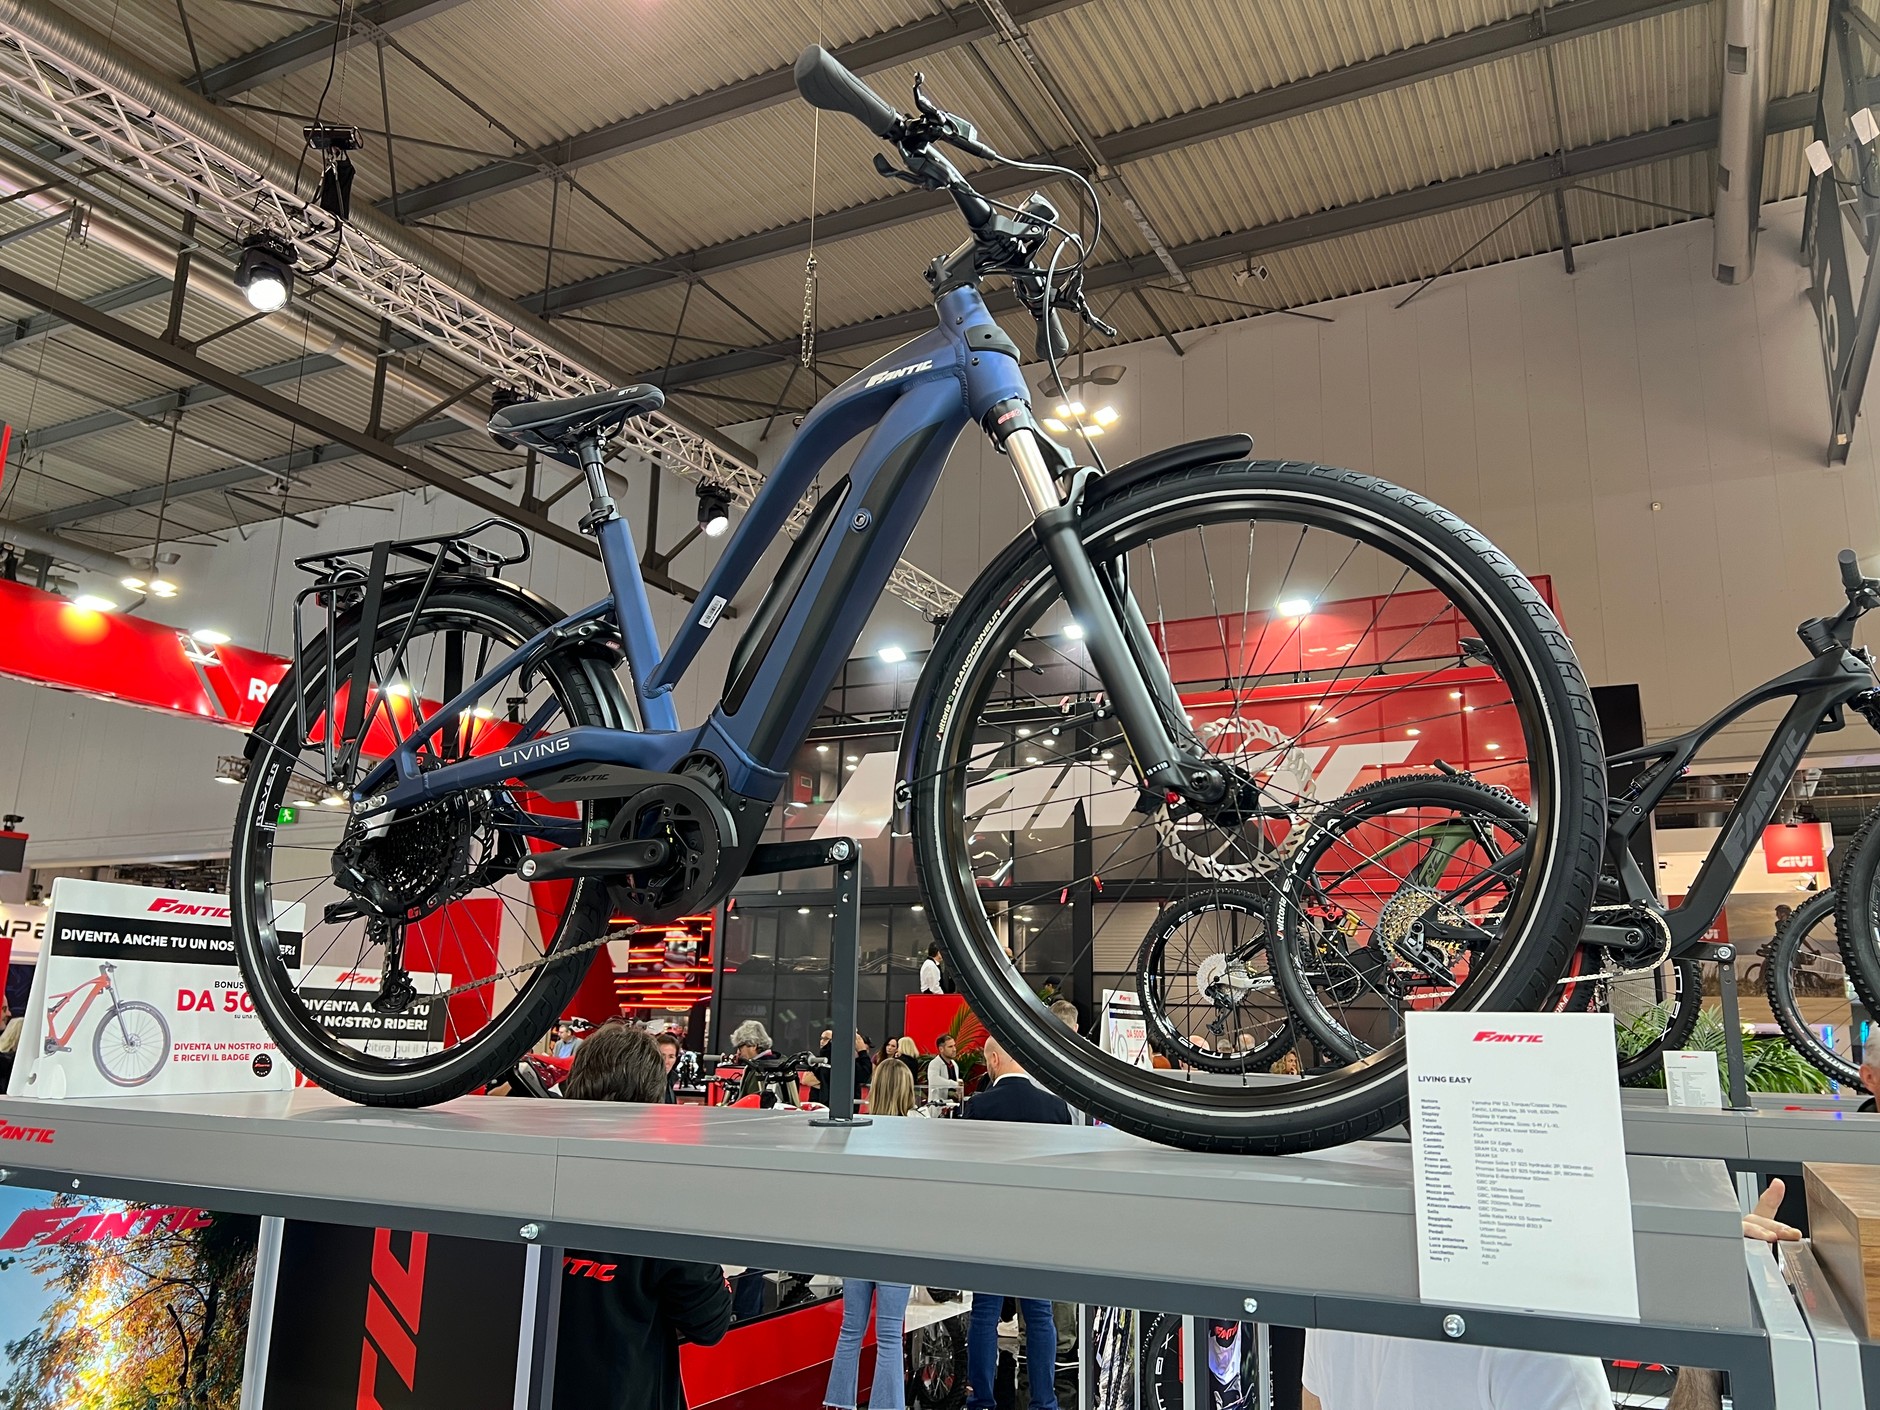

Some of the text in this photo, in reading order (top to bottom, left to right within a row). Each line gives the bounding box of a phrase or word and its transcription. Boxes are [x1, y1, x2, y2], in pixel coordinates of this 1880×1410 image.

[865, 360, 932, 388] FANTIC
[499, 737, 570, 767] LIVING
[557, 774, 609, 784] FANTIC
[256, 763, 278, 826] ROVER
[1721, 728, 1807, 872] FANTIC
[1776, 856, 1814, 868] GIVI
[147, 898, 232, 918] FANTIC
[1277, 897, 1286, 931] vittoria
[61, 929, 119, 944] DIVENTA
[123, 933, 168, 947] ANCHE
[171, 936, 187, 948] TU
[190, 938, 207, 950] UN
[210, 940, 235, 952] NOS
[214, 981, 244, 989] BONUS
[177, 989, 215, 1012] DA
[301, 999, 360, 1013] DIVENTA
[413, 1005, 430, 1015] TU
[324, 1016, 381, 1028] NOSTRO
[384, 1019, 427, 1030] RIDER!
[1472, 1031, 1544, 1043] FANTIC
[1418, 1076, 1472, 1084] LIVING EASY
[0, 1205, 214, 1250] FANTIC
